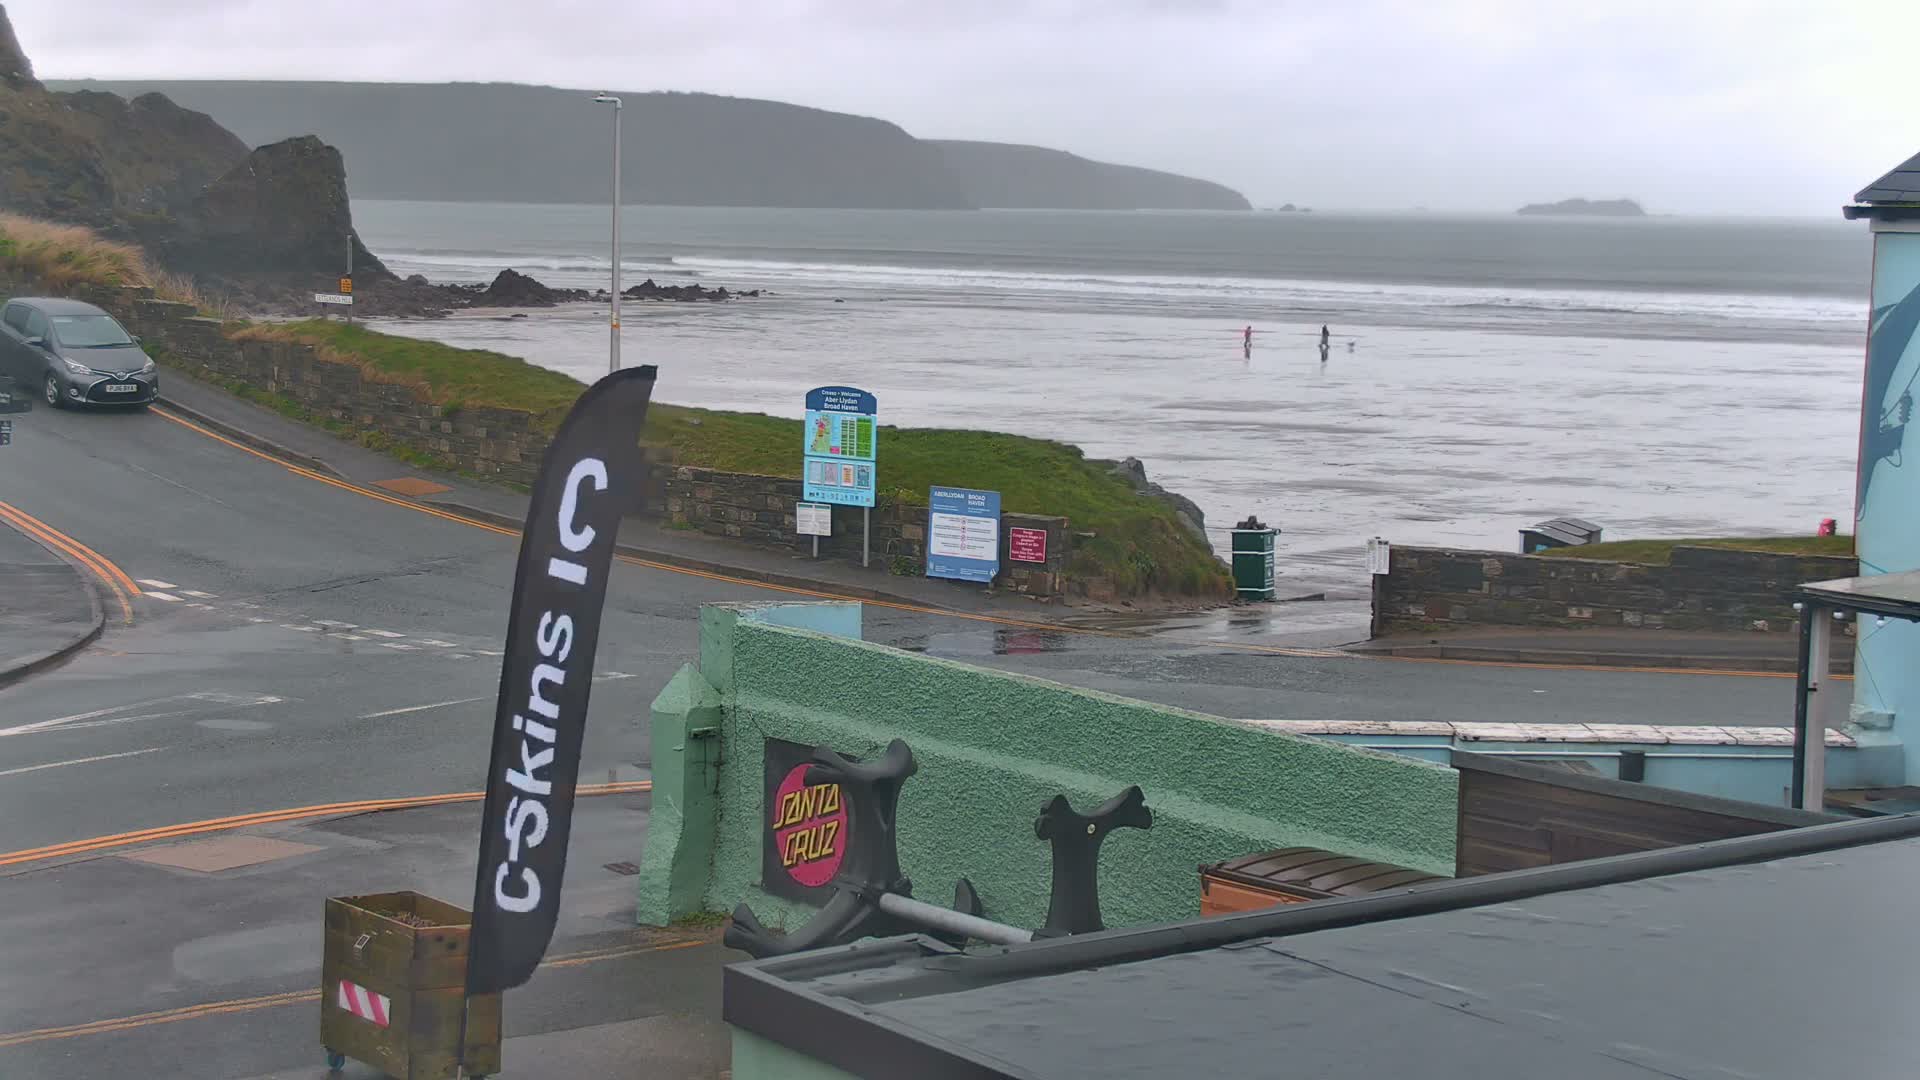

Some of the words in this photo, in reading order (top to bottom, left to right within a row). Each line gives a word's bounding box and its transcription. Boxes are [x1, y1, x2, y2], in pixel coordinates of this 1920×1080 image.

[839, 397, 858, 405] Llydan
[773, 783, 839, 829] SANTA
[783, 821, 839, 866] CRUZ
